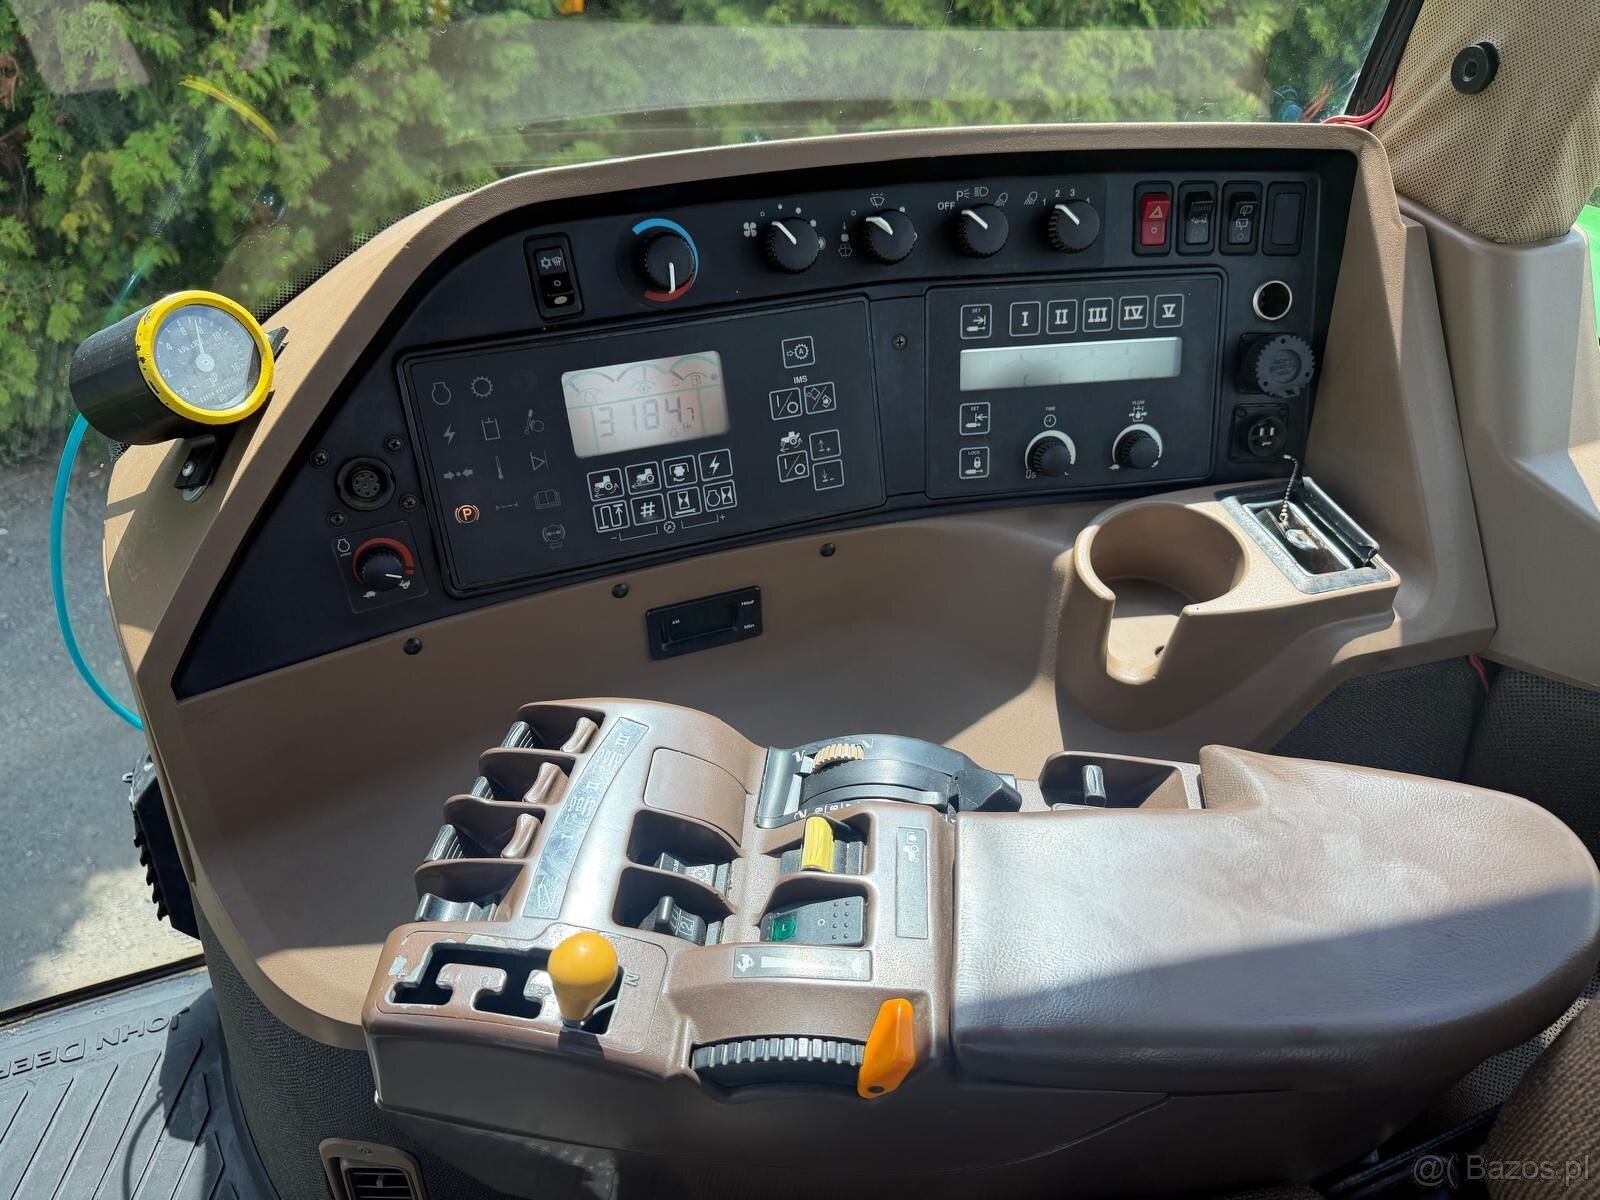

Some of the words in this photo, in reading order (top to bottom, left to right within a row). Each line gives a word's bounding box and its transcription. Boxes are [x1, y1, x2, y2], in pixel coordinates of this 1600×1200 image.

[1055, 189, 1061, 198] 2
[1069, 188, 1076, 197] 3
[937, 201, 956, 211] OFF
[1123, 304, 1143, 321] IV
[1161, 303, 1176, 319] V
[793, 375, 808, 385] IMS
[96, 1006, 190, 1051] JOHN
